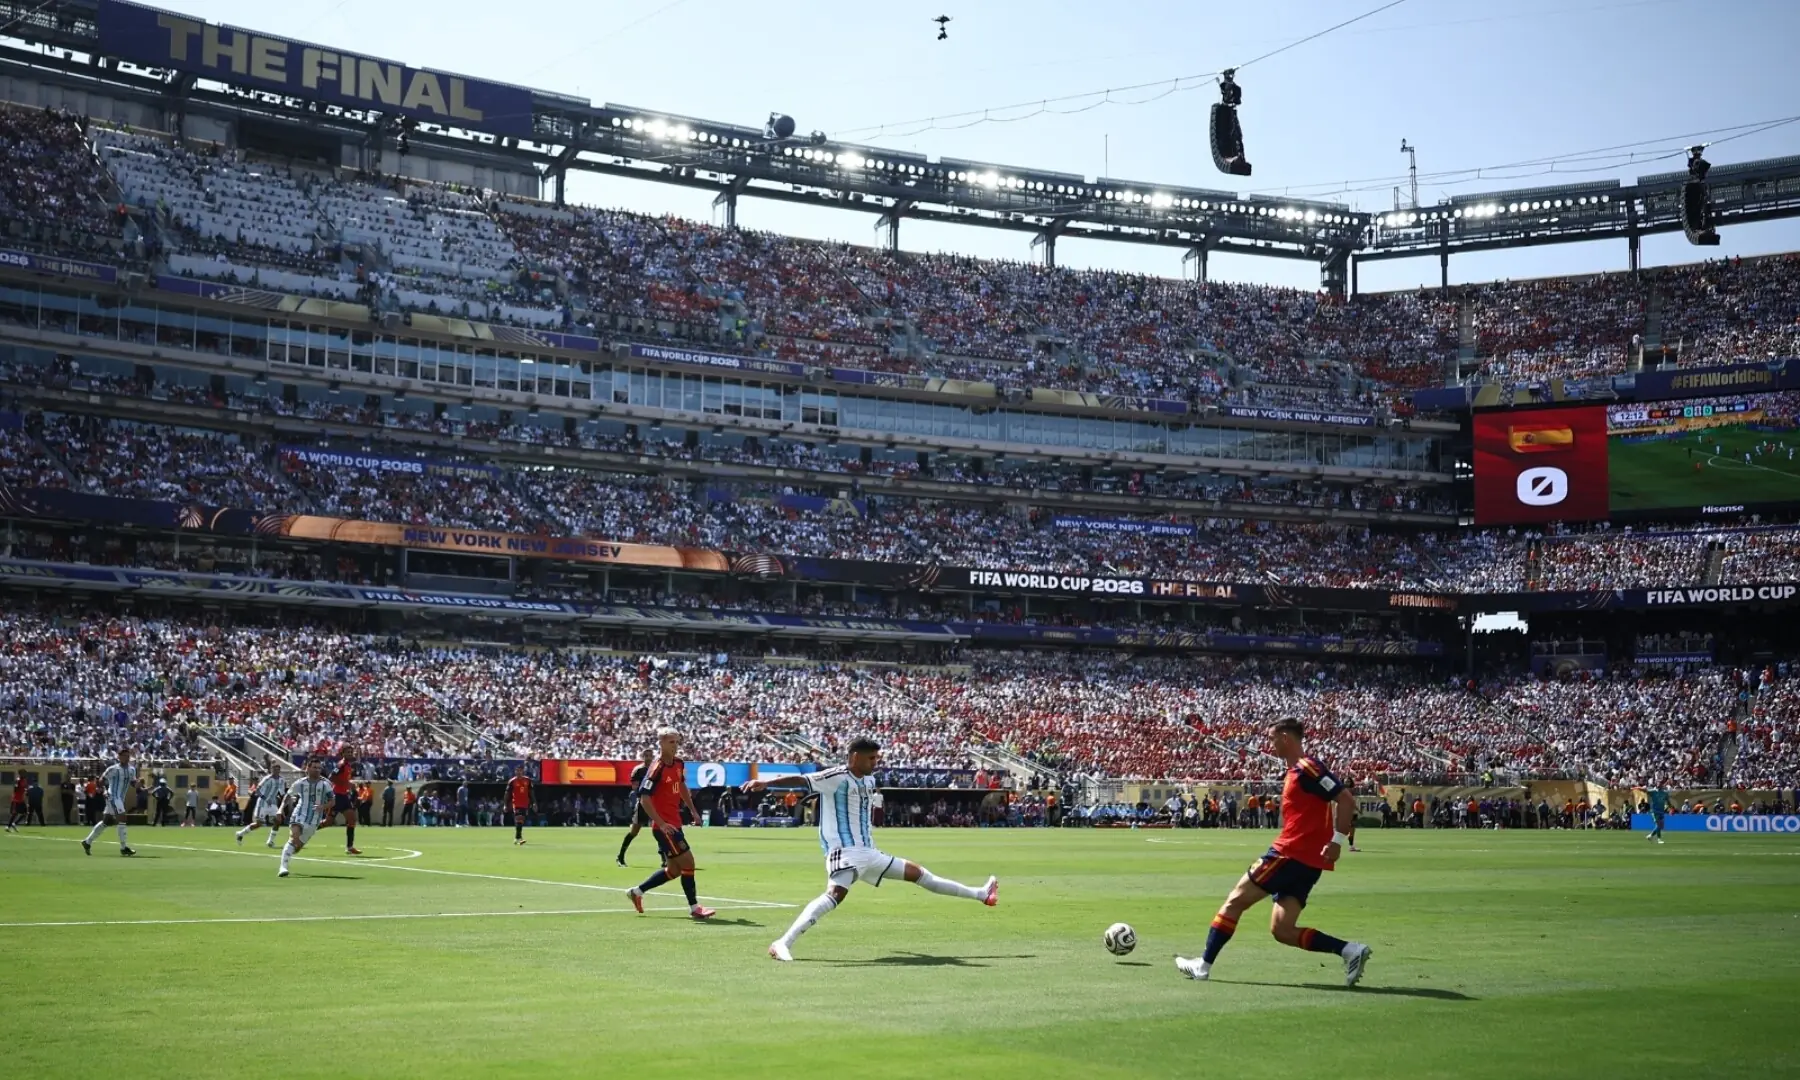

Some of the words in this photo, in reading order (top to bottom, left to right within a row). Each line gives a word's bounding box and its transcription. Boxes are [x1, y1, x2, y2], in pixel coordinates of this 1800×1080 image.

[157, 13, 288, 84] THE
[302, 47, 483, 122] FINAL
[0, 252, 29, 266] 026
[35, 258, 60, 272] THE
[61, 262, 102, 279] FINAL
[641, 346, 661, 358] FIFA
[661, 350, 691, 362] WORLD
[692, 354, 710, 364] CUP
[710, 357, 740, 368] 2026
[743, 360, 763, 371] THE
[763, 363, 793, 374] FINAL
[1231, 408, 1259, 417] NEW
[1260, 410, 1293, 420] YORK
[1295, 413, 1322, 421] NEW
[1323, 415, 1369, 425] JERSEY
[1620, 411, 1644, 421] 12:12
[355, 457, 380, 469] CUP
[381, 460, 423, 474] 2026
[428, 465, 454, 477] THE
[1516, 466, 1568, 506] 0
[1702, 504, 1744, 514] Hisense
[1055, 519, 1083, 528] NEW
[1085, 521, 1117, 531] YORK
[1119, 524, 1145, 532] NEW
[1149, 525, 1192, 536] JERSEY
[403, 528, 447, 544] NEW
[451, 532, 502, 549] YORK
[507, 538, 547, 553] NEW
[969, 570, 1002, 587] FIFA
[1004, 573, 1058, 590] WORLD
[1061, 576, 1090, 592] CUP
[1092, 579, 1144, 594] 2026
[1151, 581, 1185, 596] THE
[1186, 584, 1237, 599] FINAL
[365, 591, 404, 601] FIFA
[468, 599, 502, 608] CUP
[502, 600, 562, 612] 2026
[1646, 589, 1685, 605] FIFA
[1688, 587, 1755, 603] WORLD
[1757, 586, 1796, 600] CUP
[1706, 814, 1800, 832] aramco
